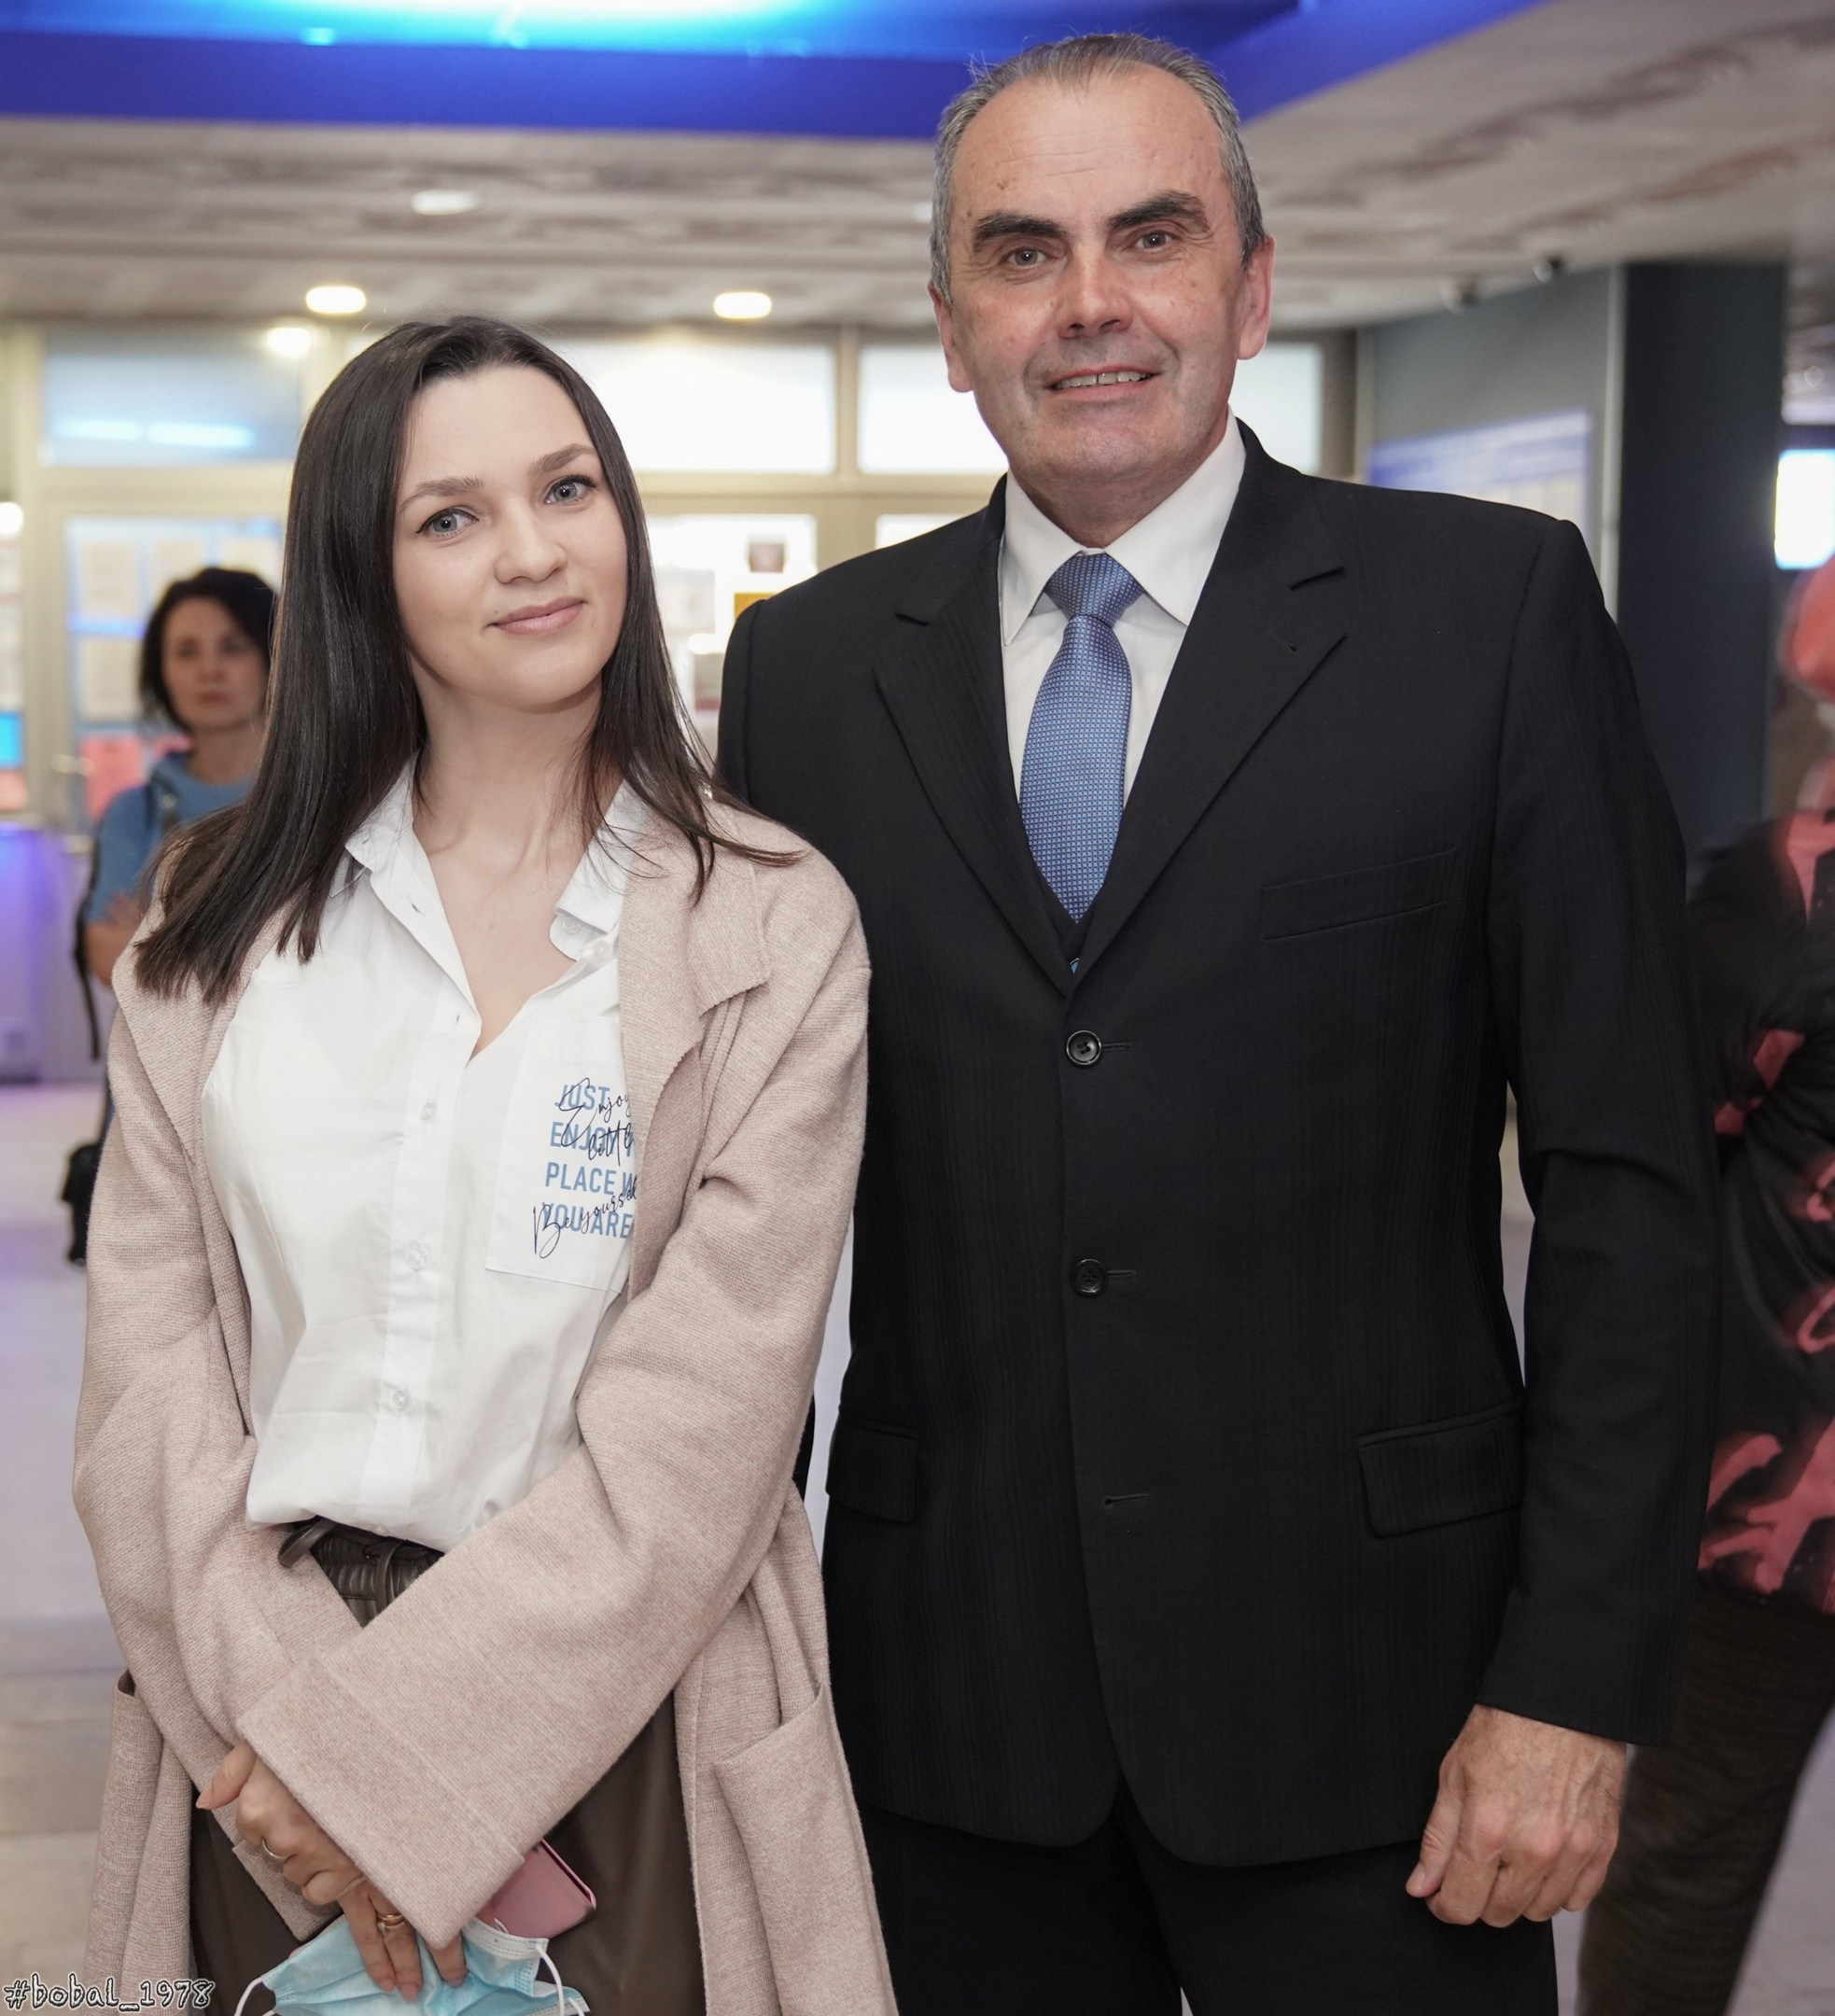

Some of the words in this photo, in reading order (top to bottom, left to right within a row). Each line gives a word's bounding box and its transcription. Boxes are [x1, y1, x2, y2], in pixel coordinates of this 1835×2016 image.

[553, 1085, 610, 1111] JUST
[545, 1162, 616, 1196] PLACE
[540, 1202, 584, 1232] YOU
[589, 1211, 633, 1239] ARE
